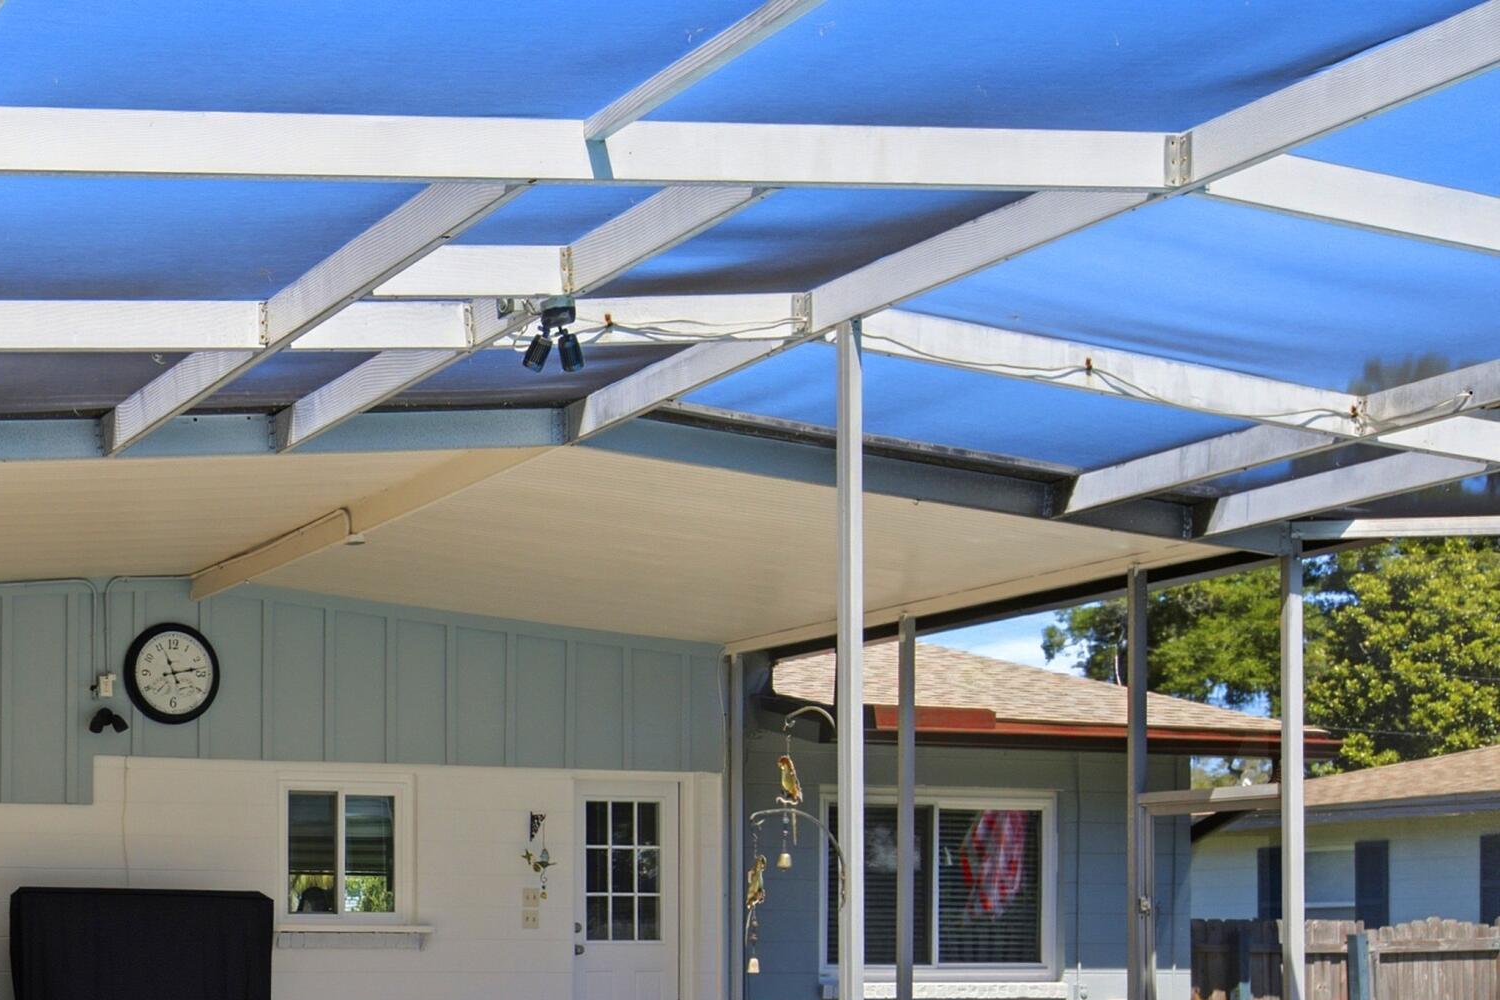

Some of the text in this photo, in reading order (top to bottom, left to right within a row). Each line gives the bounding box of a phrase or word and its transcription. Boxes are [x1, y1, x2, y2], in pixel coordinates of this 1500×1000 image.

[168, 639, 179, 650] 12
[144, 653, 154, 663] 10
[141, 669, 152, 677] 9
[169, 696, 177, 708] 6
